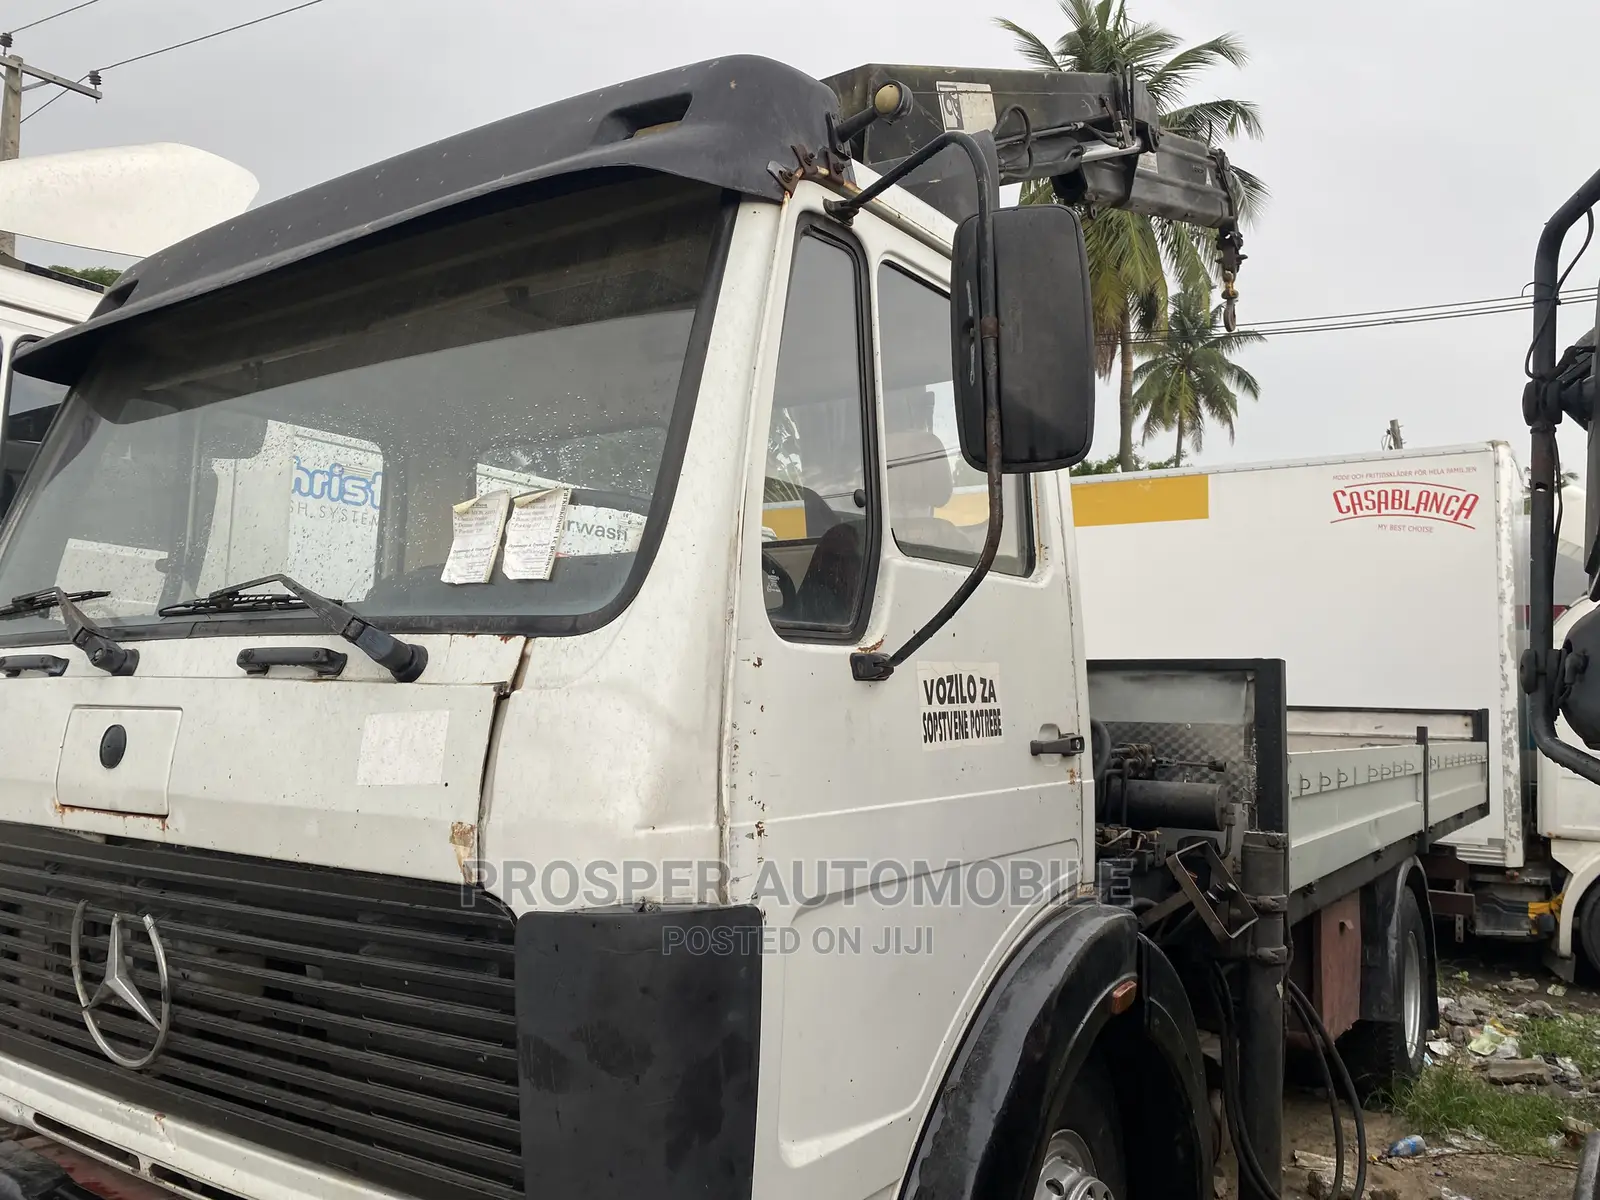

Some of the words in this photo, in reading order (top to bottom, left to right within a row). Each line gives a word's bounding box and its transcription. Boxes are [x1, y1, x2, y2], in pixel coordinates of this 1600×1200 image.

[1414, 468, 1427, 476] FÖR
[1446, 466, 1477, 474] FAMILJEN
[1332, 489, 1479, 522] CASABLANCA
[562, 519, 628, 542] rwash
[1377, 523, 1388, 531] MY
[1389, 524, 1406, 532] BEST
[1407, 525, 1434, 534] CHOISE
[923, 673, 977, 705] VOZILO
[979, 676, 997, 703] ZA
[922, 710, 969, 744] SOPSTVENE
[970, 708, 1003, 739] POTREBE
